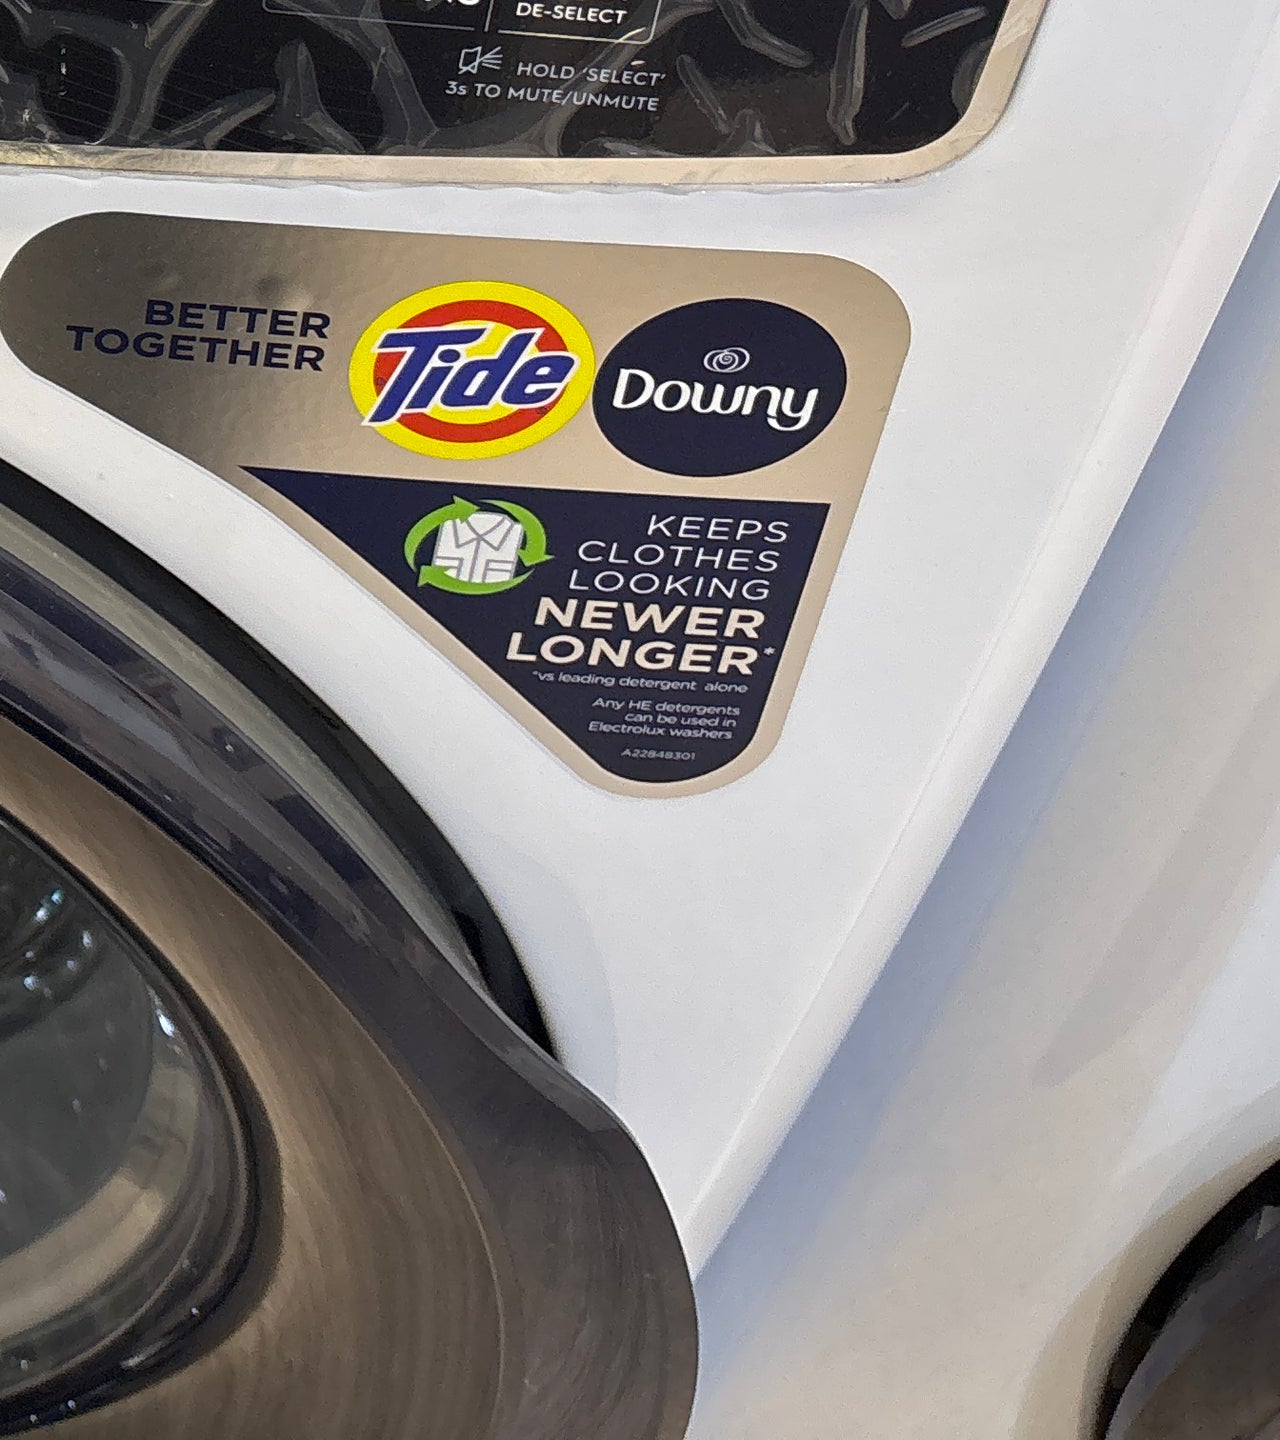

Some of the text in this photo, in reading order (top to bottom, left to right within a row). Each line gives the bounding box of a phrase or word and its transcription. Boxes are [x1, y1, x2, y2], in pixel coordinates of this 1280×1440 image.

[514, 0, 628, 27] DE-SELECT
[516, 60, 576, 82] HOLD
[444, 79, 661, 113] 3s TO MUTE/UNMUTE
[144, 297, 332, 341] BETTER
[65, 323, 327, 373] TOGETHER
[362, 326, 576, 428] Tide
[611, 367, 820, 433] Downy
[646, 513, 790, 544] KEEPS
[576, 539, 781, 574] CLOTHES
[567, 567, 772, 602] LOOKING
[533, 595, 766, 640] NEWER
[557, 670, 616, 688] leading
[618, 675, 698, 693] detergent
[704, 680, 749, 694] alone
[591, 696, 741, 717] Any HE detergents
[624, 712, 737, 728] can be used in
[587, 720, 733, 741] Electrolux washers
